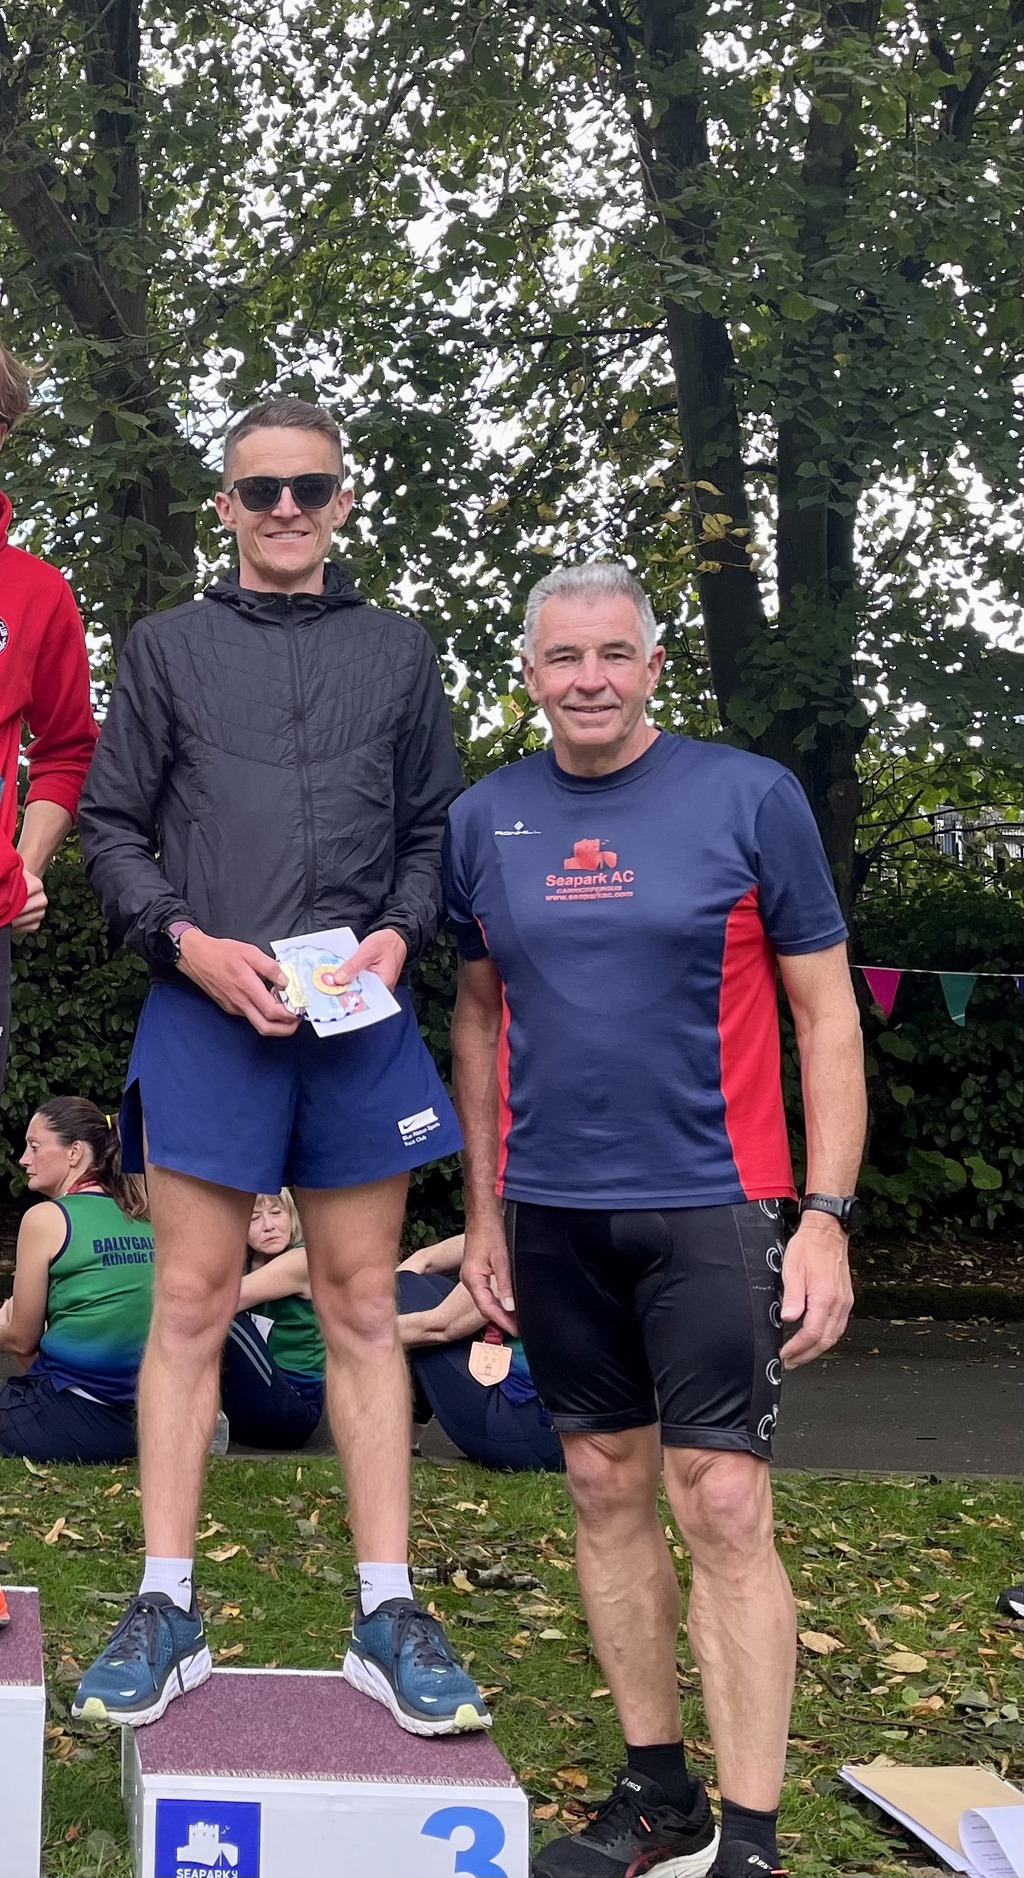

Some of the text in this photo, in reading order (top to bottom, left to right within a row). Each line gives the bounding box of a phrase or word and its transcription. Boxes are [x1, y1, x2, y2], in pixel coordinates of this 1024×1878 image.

[545, 869, 634, 888] Seapark AC
[102, 1251, 148, 1267] Athletic
[420, 1806, 508, 1878] 3
[176, 1868, 231, 1878] SEAPARK
